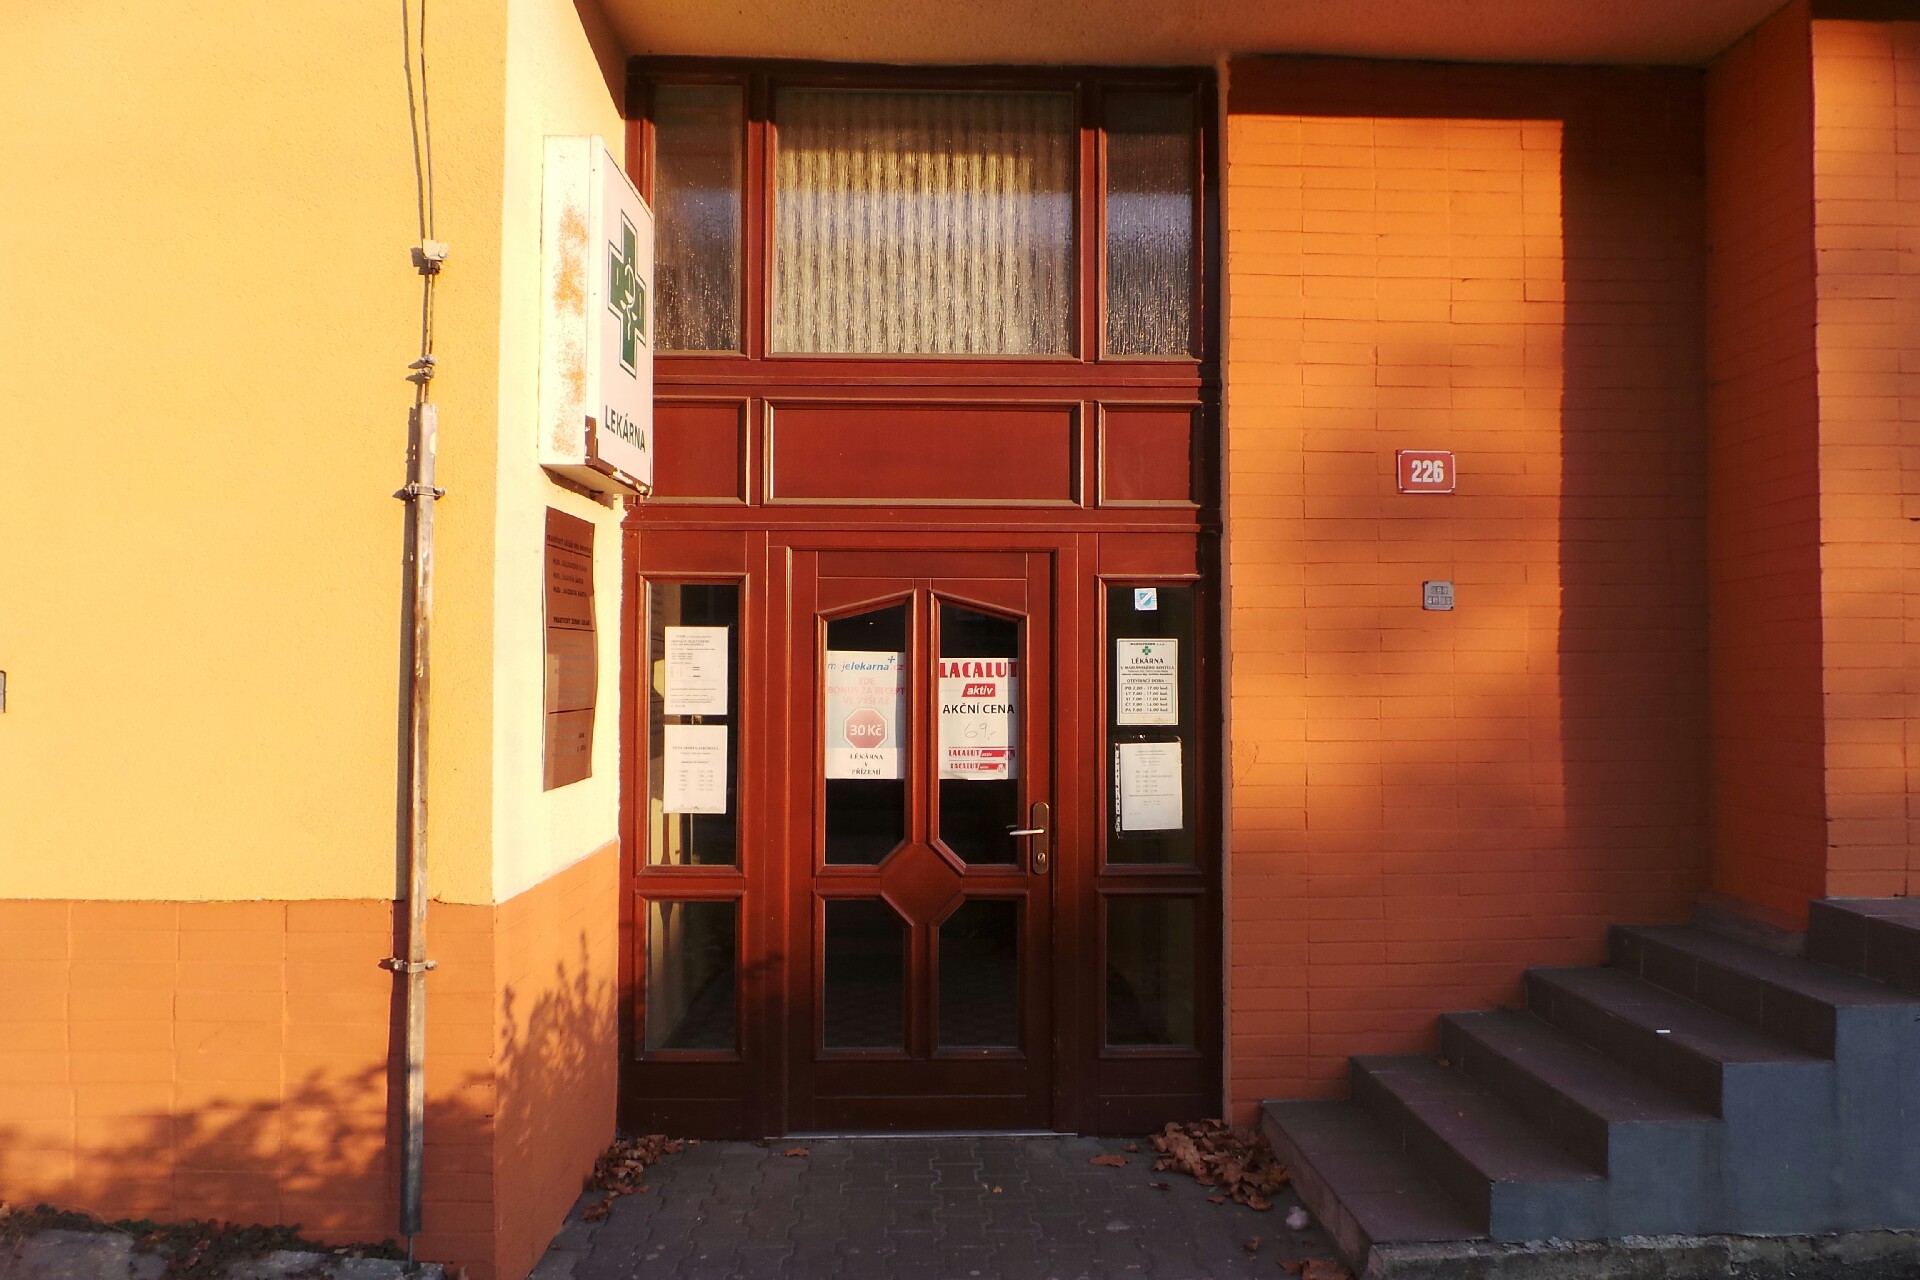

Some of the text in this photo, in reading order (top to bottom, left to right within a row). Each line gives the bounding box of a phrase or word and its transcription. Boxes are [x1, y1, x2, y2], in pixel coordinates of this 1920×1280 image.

[605, 404, 645, 453] LEKÁRNA
[1411, 459, 1444, 483] 226
[939, 662, 1019, 678] LACALUT
[966, 685, 994, 695] aktiv
[942, 702, 1015, 714] AKČNÍ CENA
[850, 723, 882, 736] 30 Kč
[949, 749, 980, 757] LACALUT
